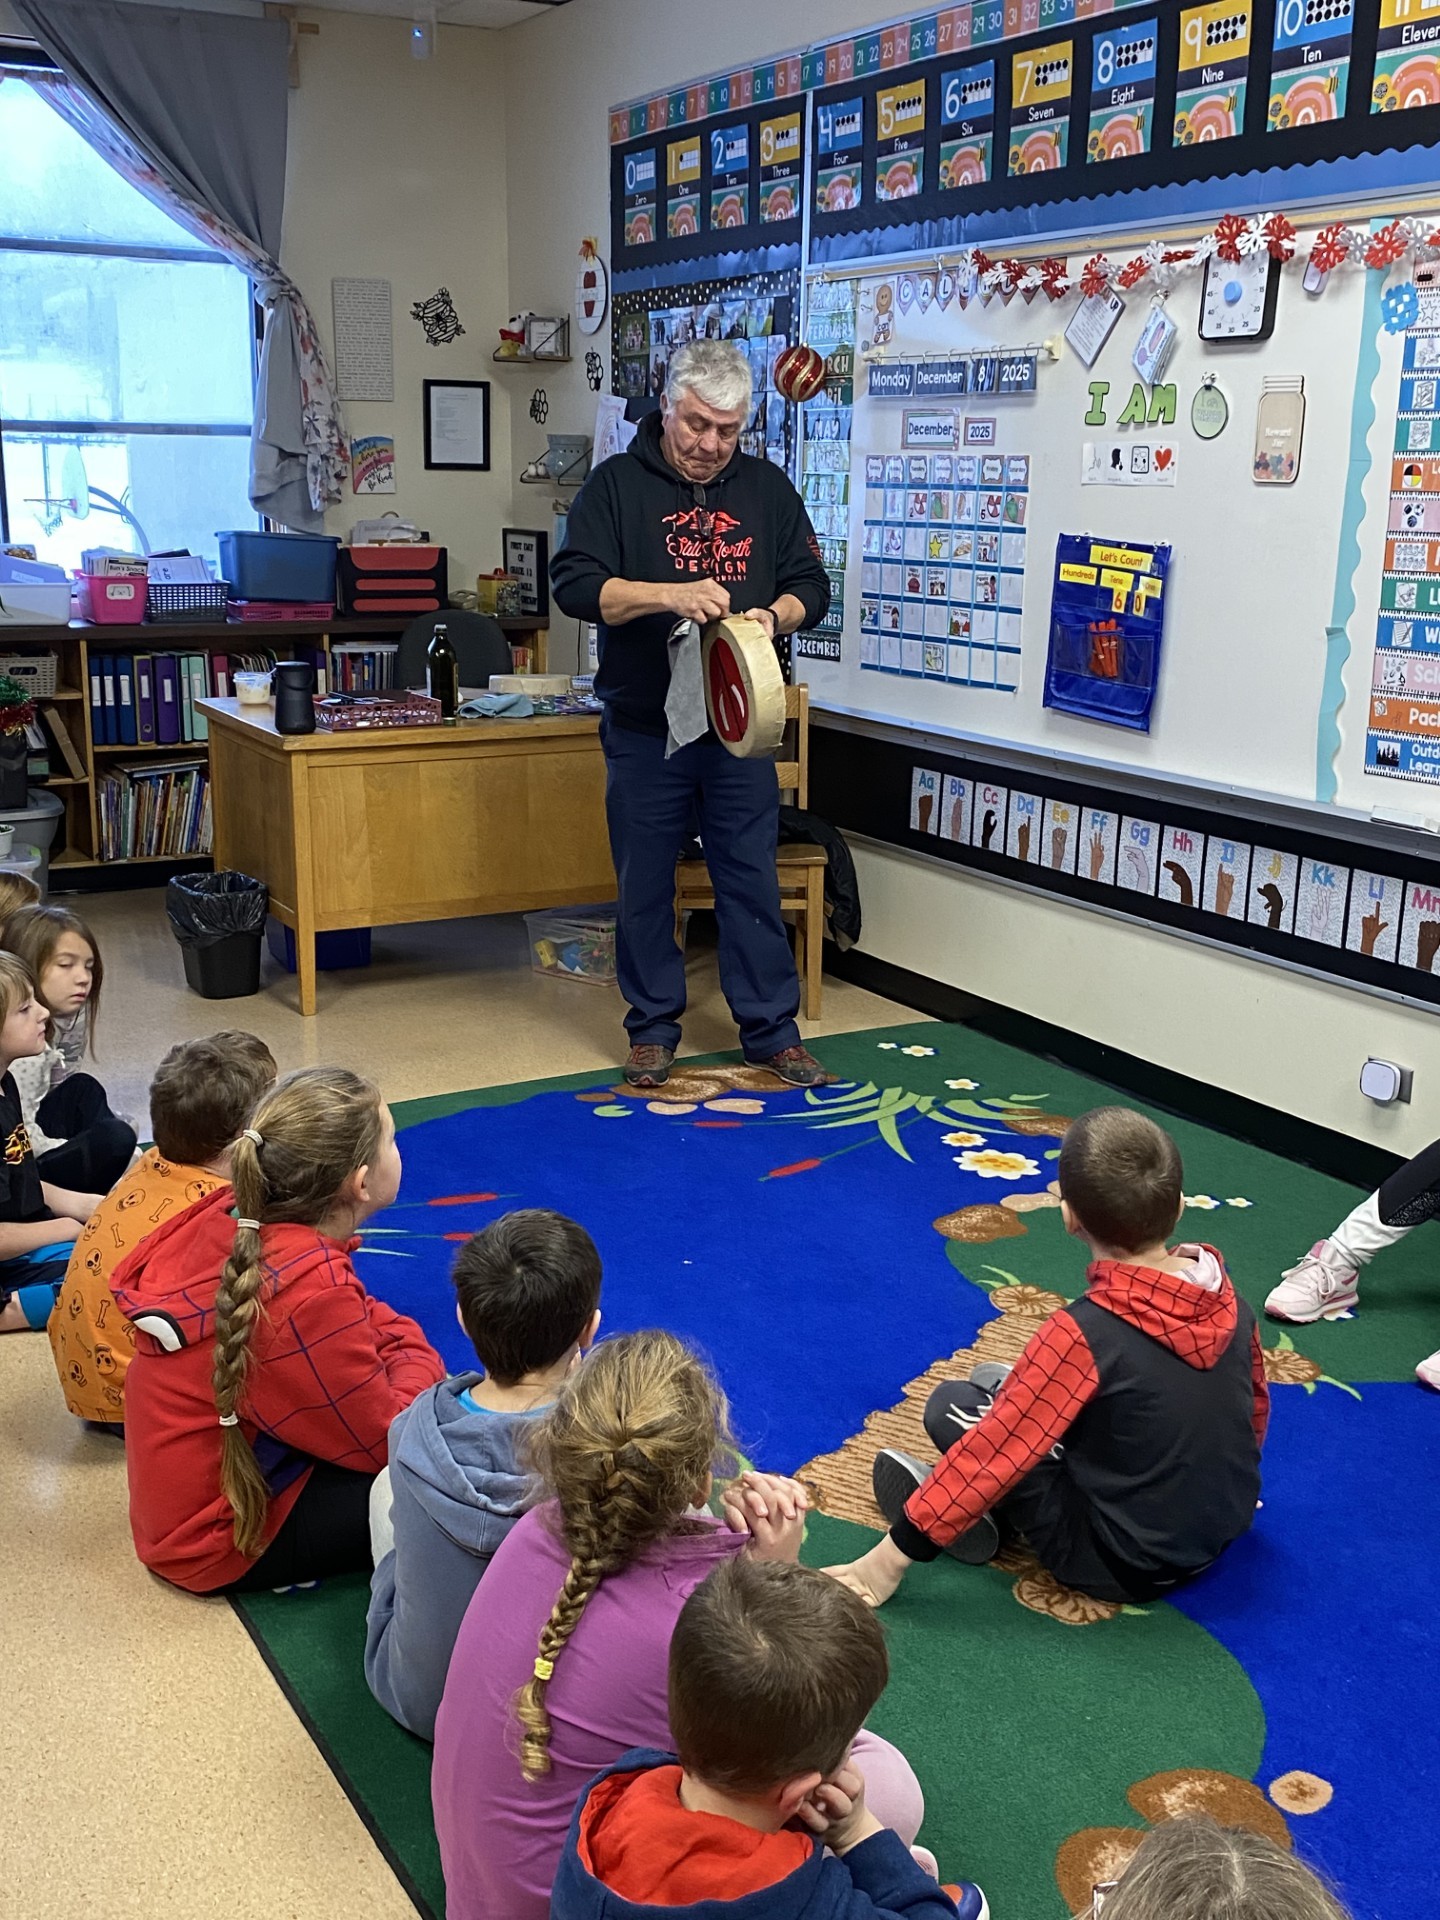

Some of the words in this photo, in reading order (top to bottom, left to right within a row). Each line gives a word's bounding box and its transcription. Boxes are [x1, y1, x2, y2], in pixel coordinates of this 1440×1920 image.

[1277, 0, 1301, 40] 10
[1185, 16, 1203, 62] 9
[641, 114, 646, 127] 2
[650, 110, 656, 124] 3
[660, 106, 665, 119] 4
[669, 105, 674, 118] 5
[679, 102, 685, 115] 6
[689, 98, 695, 113] 7
[699, 95, 705, 108] 8
[710, 92, 716, 104] 9
[720, 87, 728, 102] 10
[744, 83, 750, 96] 12
[754, 80, 761, 94] 13
[778, 72, 785, 87] 15
[790, 69, 798, 84] 16
[803, 66, 810, 81] 17
[816, 62, 823, 77] 18
[828, 59, 836, 73] 19
[840, 54, 851, 71] 20
[856, 49, 864, 66] 21
[869, 45, 879, 63] 22
[882, 42, 893, 59] 23
[897, 38, 908, 54] 24
[911, 32, 921, 50] 25
[924, 28, 936, 46] 26
[939, 23, 951, 42] 27
[956, 20, 969, 38] 28
[973, 16, 985, 34] 29
[988, 10, 1003, 30] 30
[1008, 7, 1018, 26] 31
[1023, 2, 1037, 22] 32
[1041, 0, 1055, 16] 33
[1097, 40, 1115, 84] 8
[1301, 46, 1322, 64] Ten
[1016, 60, 1034, 103] 7
[1201, 67, 1225, 85] Nine
[945, 78, 960, 119] 6
[1111, 86, 1136, 106] Eight
[880, 95, 894, 135] 5
[1028, 106, 1055, 122] Seven
[819, 109, 832, 149] 4
[961, 122, 974, 136] Six
[713, 136, 725, 170] 2
[761, 126, 774, 162] 3
[894, 138, 909, 151] Five
[671, 149, 676, 180] 1
[833, 153, 849, 166] Four
[626, 160, 636, 190] 0
[725, 174, 737, 185] Two
[772, 165, 790, 176] Three
[678, 185, 689, 196] One
[635, 194, 648, 206] Zero
[877, 322, 890, 332] can
[826, 355, 849, 374] RCH
[872, 371, 911, 389] Monday
[917, 369, 963, 385] December
[977, 365, 985, 383] 8
[1002, 364, 1030, 382] 2025
[1085, 381, 1110, 425] I
[1116, 383, 1177, 425] AM
[814, 420, 840, 439] MAY
[908, 421, 953, 436] December
[970, 425, 990, 438] 2025
[1265, 427, 1292, 437] Reward
[1272, 439, 1284, 448] Jar
[909, 507, 914, 518] 2
[966, 507, 971, 518] 4
[1018, 499, 1024, 510] 6
[981, 509, 986, 520] 5
[675, 557, 747, 575] DESIGN
[1100, 550, 1118, 563] Let's
[1120, 554, 1143, 567] Count
[714, 574, 747, 582] OMPANY
[1062, 568, 1095, 580] Hundreds
[1110, 575, 1124, 585] Tens
[1114, 592, 1123, 610] 6
[1135, 594, 1142, 613] 0
[918, 771, 934, 791] Aa
[950, 778, 965, 798] Bb
[983, 787, 998, 804] Cc
[1017, 794, 1035, 815] Dd
[1052, 803, 1070, 824] Ee
[1091, 812, 1109, 831] Ff
[1130, 821, 1150, 846] Gg
[1172, 830, 1193, 853] Hh
[1311, 863, 1336, 888] Kk
